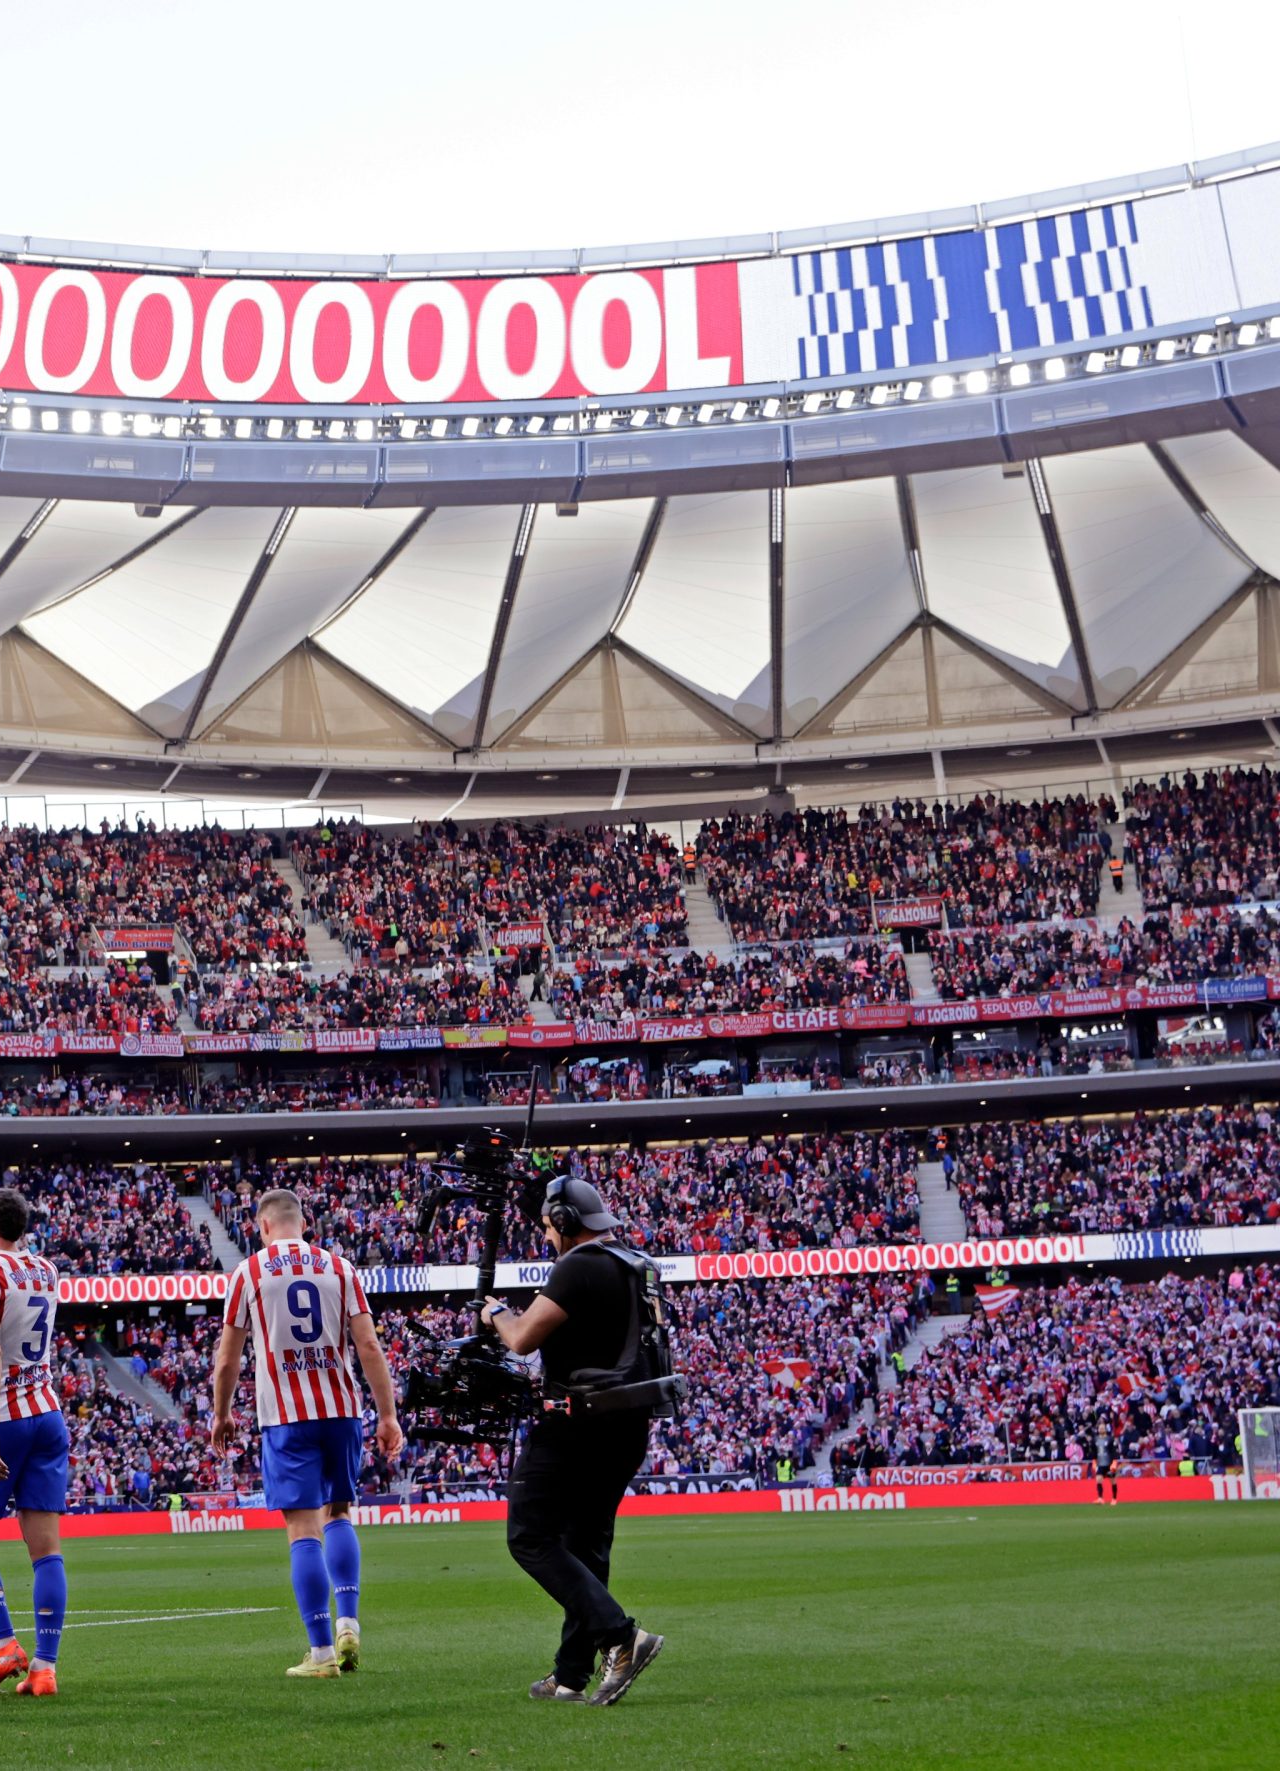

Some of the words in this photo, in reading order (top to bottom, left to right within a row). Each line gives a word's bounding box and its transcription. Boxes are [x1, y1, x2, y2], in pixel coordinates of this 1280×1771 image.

[890, 905, 939, 922] GAMONAL
[497, 928, 541, 946] ALCOBENDAS
[1147, 993, 1196, 1006] MUÑOZ
[772, 1010, 839, 1029] GETAFE
[928, 1005, 978, 1023] LOGROÑO
[316, 1030, 376, 1046] BOADILLA
[590, 1020, 637, 1040] SONSECA
[642, 1023, 703, 1040] TIELMES
[62, 1036, 116, 1049] PALENCIA
[196, 1039, 248, 1051] MARAGATA
[260, 1039, 313, 1050] BRUSELAS
[380, 1040, 409, 1049] COLLADO
[410, 1038, 442, 1048] VILLALBA
[264, 1253, 328, 1273] SØRLOTH
[518, 1266, 552, 1283] KOK
[287, 1280, 323, 1343] 9
[21, 1296, 49, 1361] 3
[293, 1347, 327, 1359] VISIT
[282, 1359, 339, 1373] RWANDA
[876, 1469, 959, 1486] NACIDOS
[1023, 1465, 1082, 1482] MORIR
[778, 1487, 906, 1512] Mahou
[170, 1510, 245, 1533] Mahou
